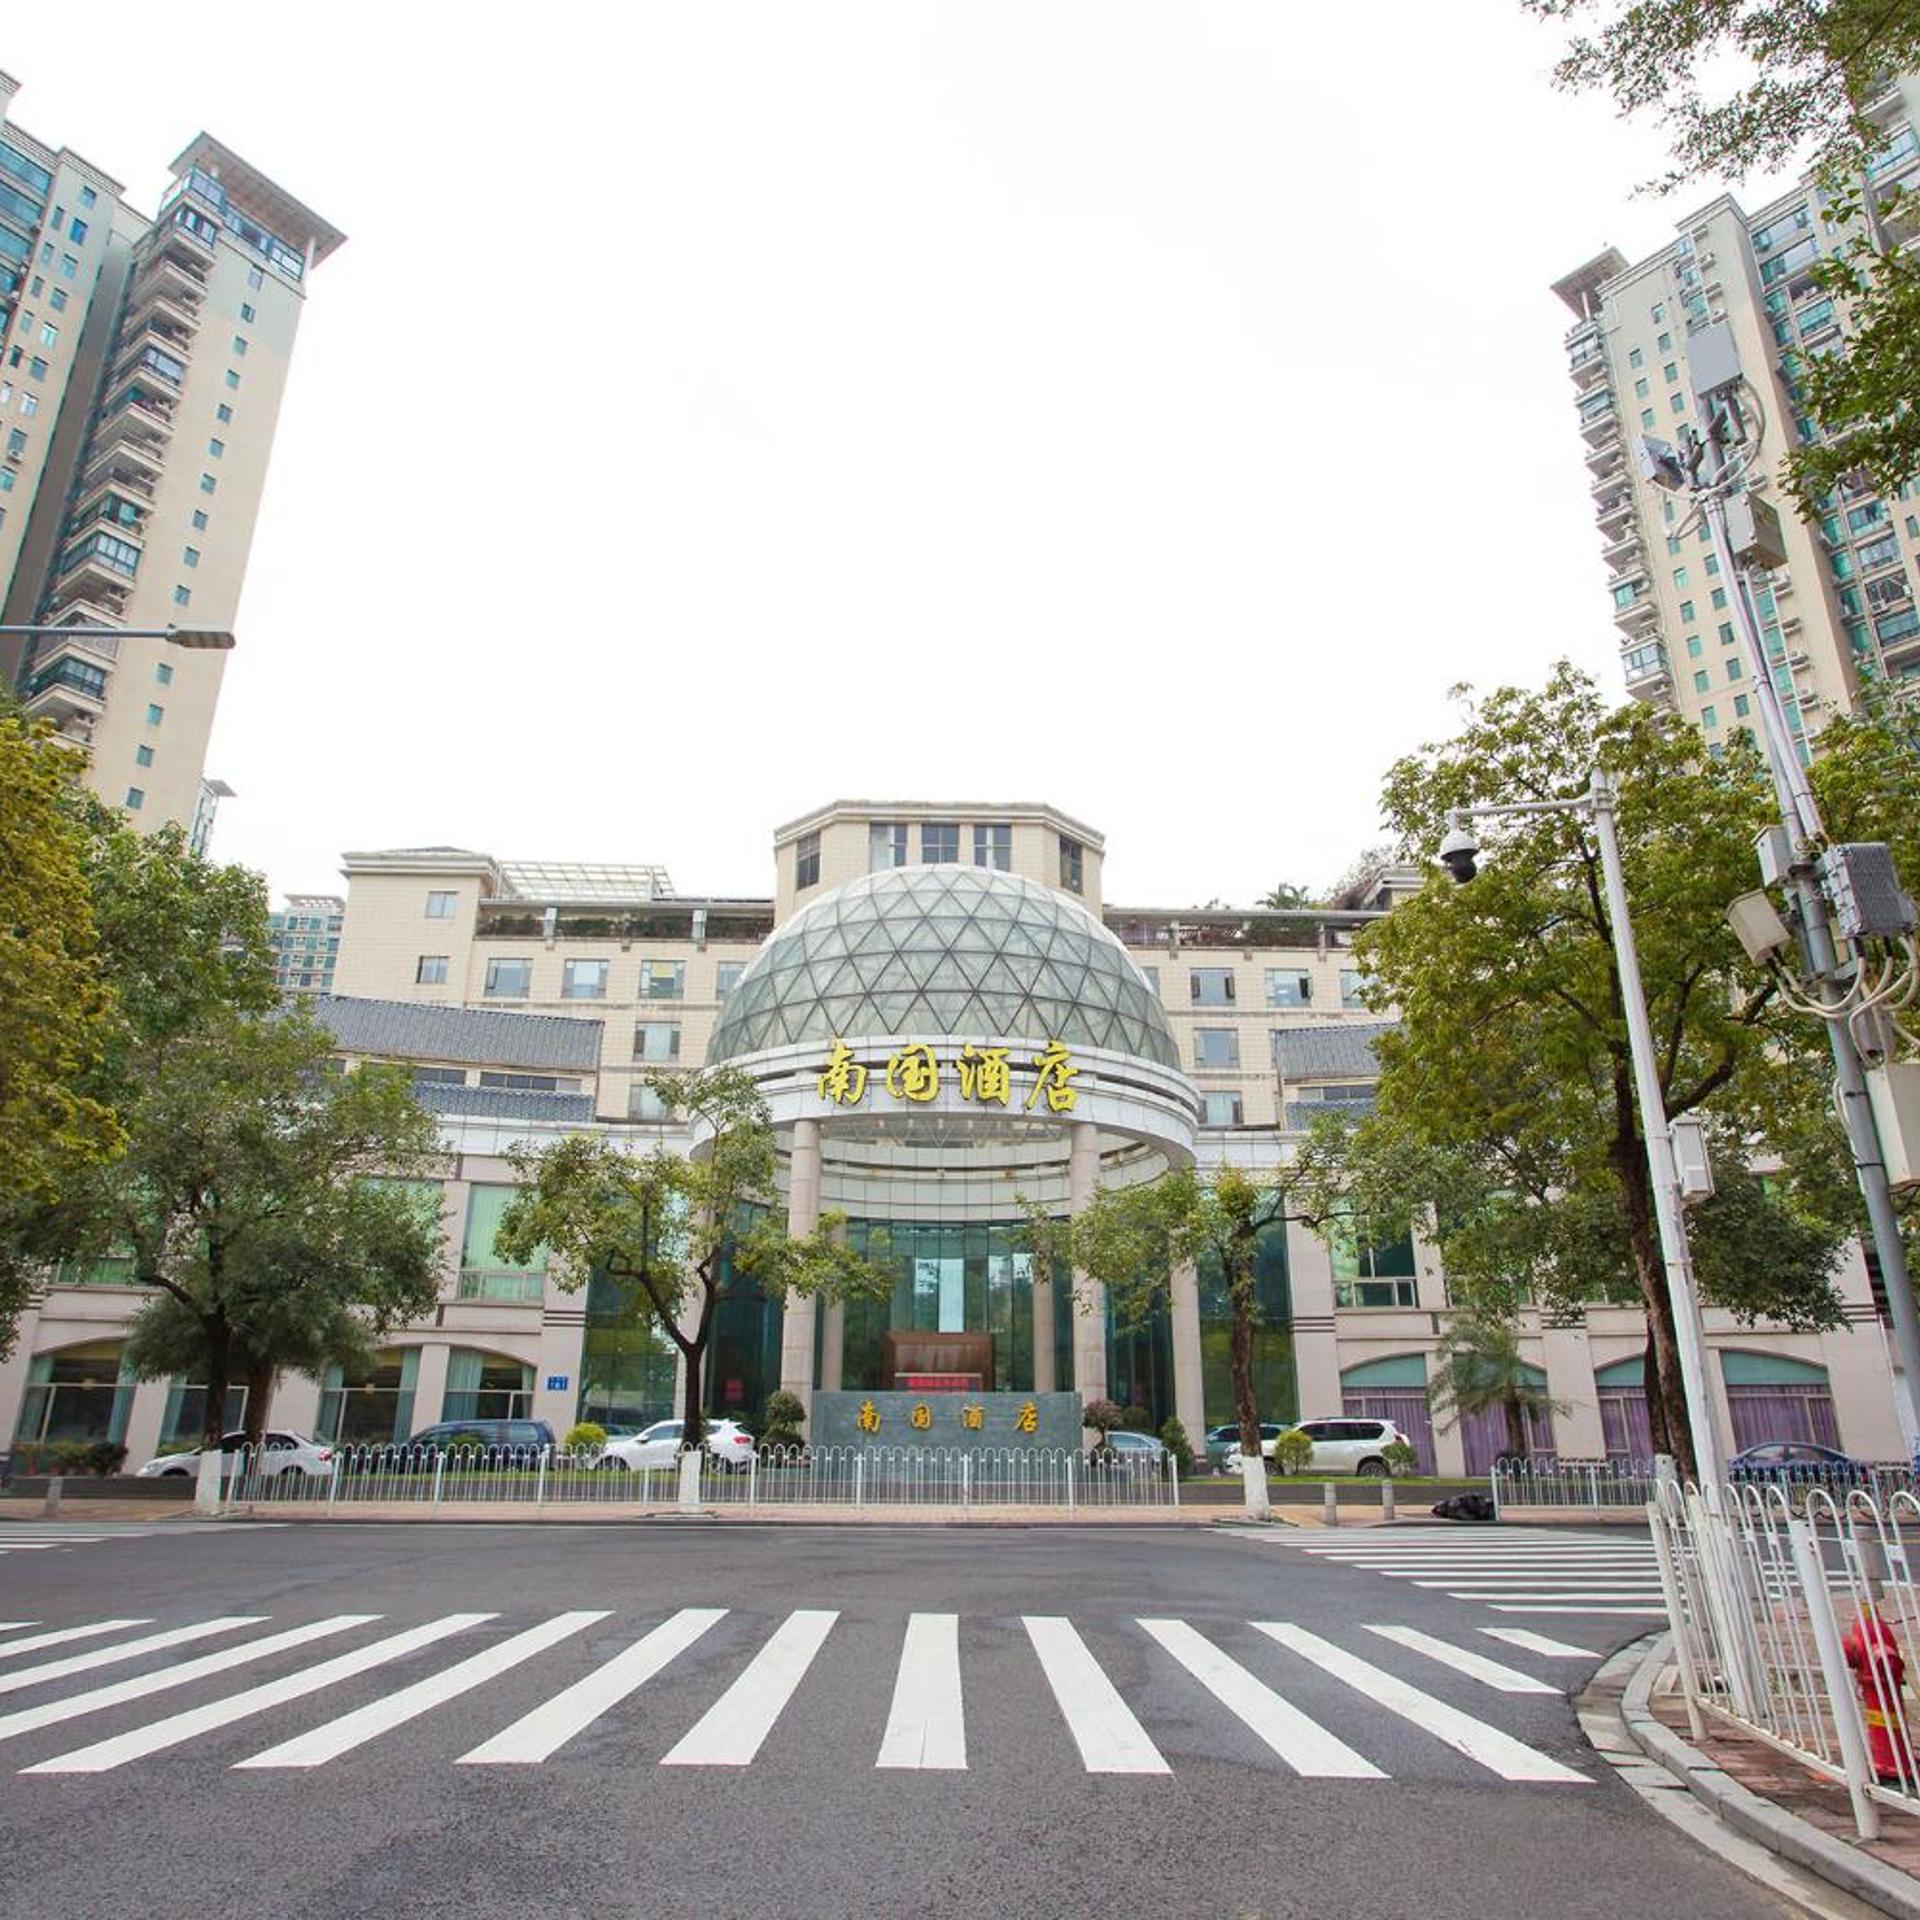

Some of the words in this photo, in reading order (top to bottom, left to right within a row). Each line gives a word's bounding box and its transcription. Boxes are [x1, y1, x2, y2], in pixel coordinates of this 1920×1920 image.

[818, 1039, 1079, 1112] 南国酒店
[857, 1400, 1038, 1433] 南国酒店
